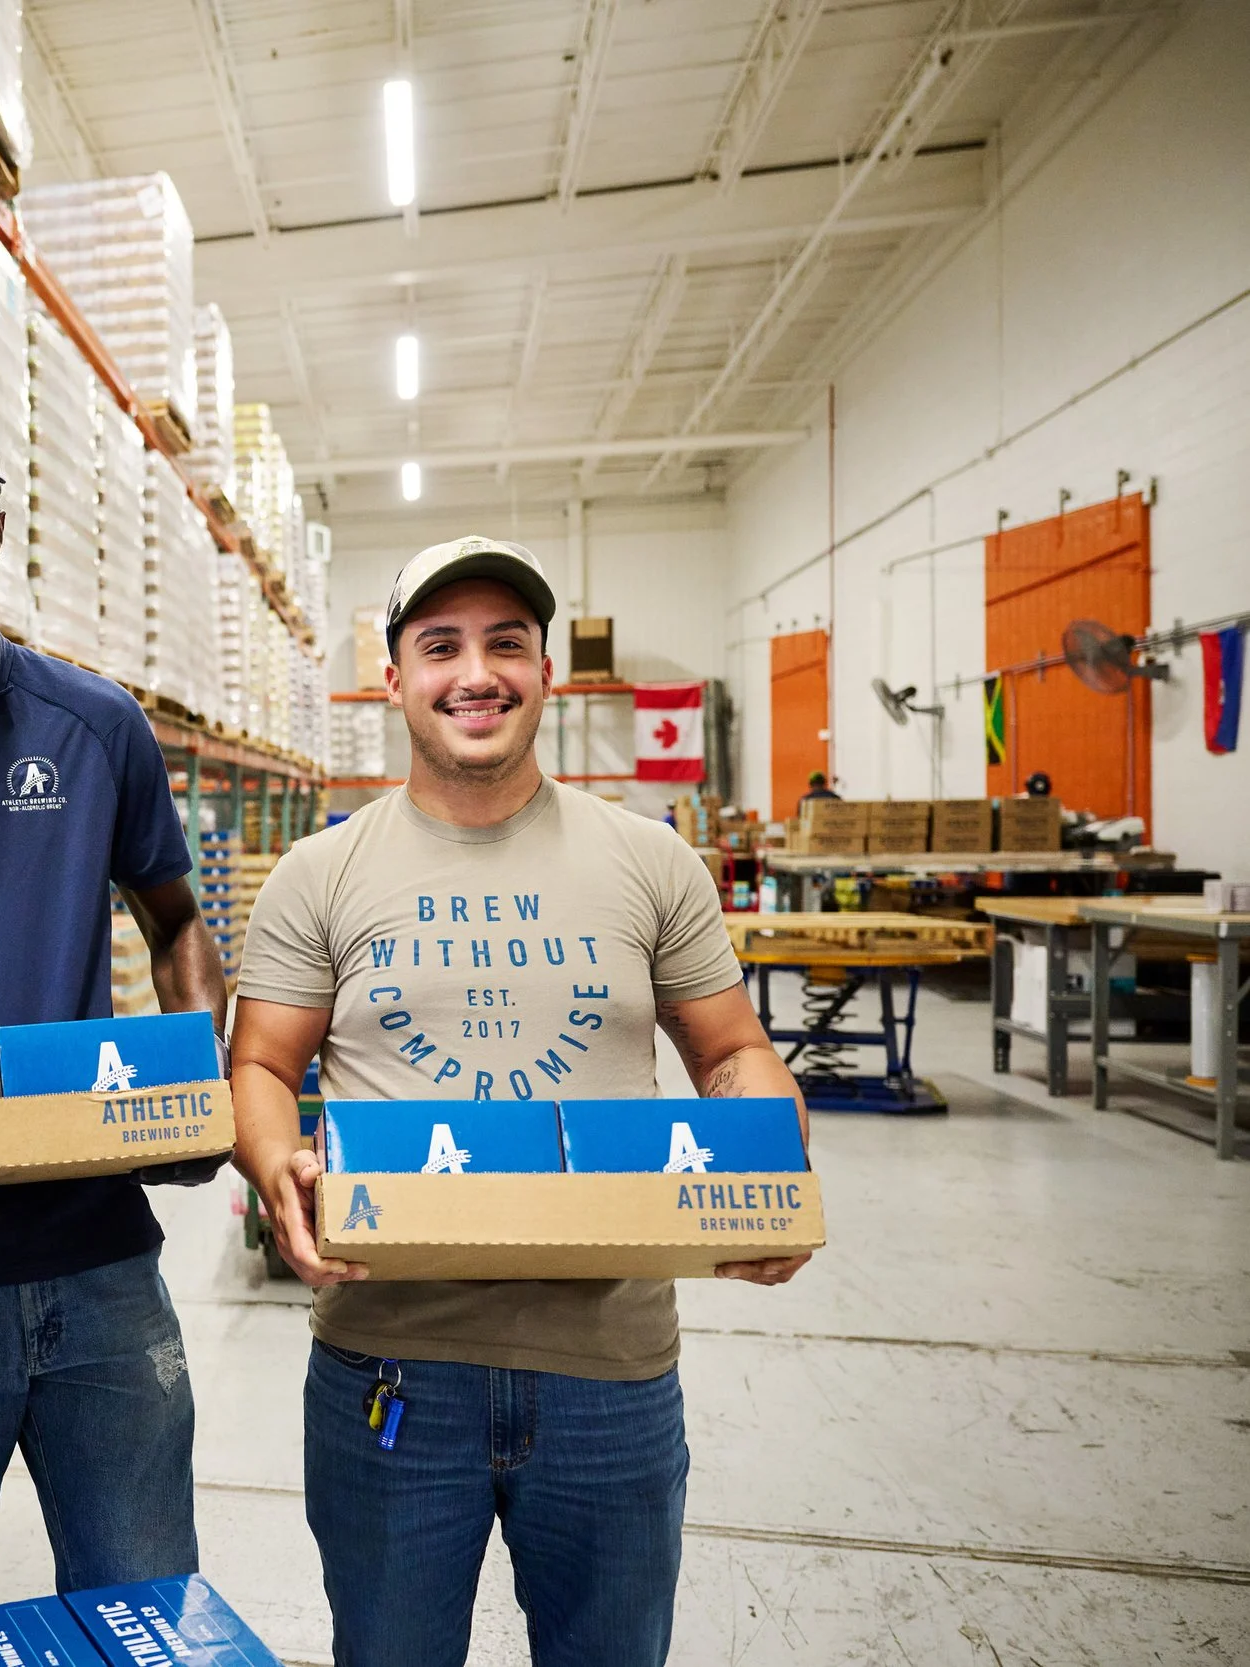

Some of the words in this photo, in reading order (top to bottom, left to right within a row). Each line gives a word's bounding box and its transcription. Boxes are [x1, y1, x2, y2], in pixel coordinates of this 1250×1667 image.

[418, 894, 539, 922] BREW
[370, 937, 598, 968] WITHOUT
[467, 989, 516, 1007] EST.
[369, 984, 608, 1100] COMPROMISE
[462, 1020, 520, 1038] 2017
[102, 1092, 212, 1124] ATHLETIC
[122, 1127, 180, 1143] BREWING
[678, 1184, 802, 1209] ATHLETIC
[700, 1218, 764, 1231] BREWING
[150, 1618, 192, 1657] BREWING
